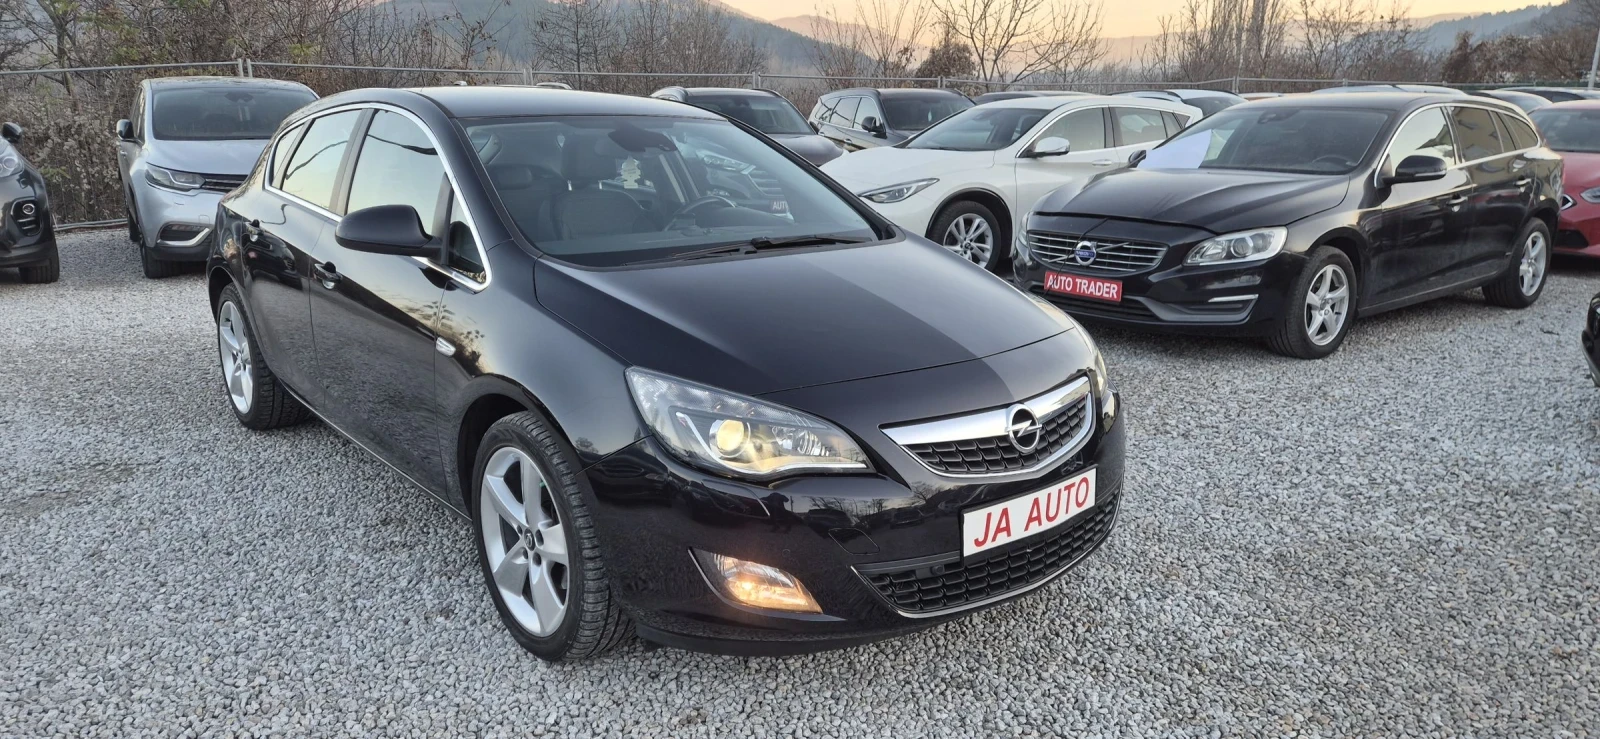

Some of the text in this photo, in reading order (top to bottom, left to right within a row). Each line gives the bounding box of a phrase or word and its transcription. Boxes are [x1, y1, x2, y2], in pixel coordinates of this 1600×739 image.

[1046, 274, 1118, 299] AUTO TRADER
[974, 476, 1090, 547] JA AUTO
